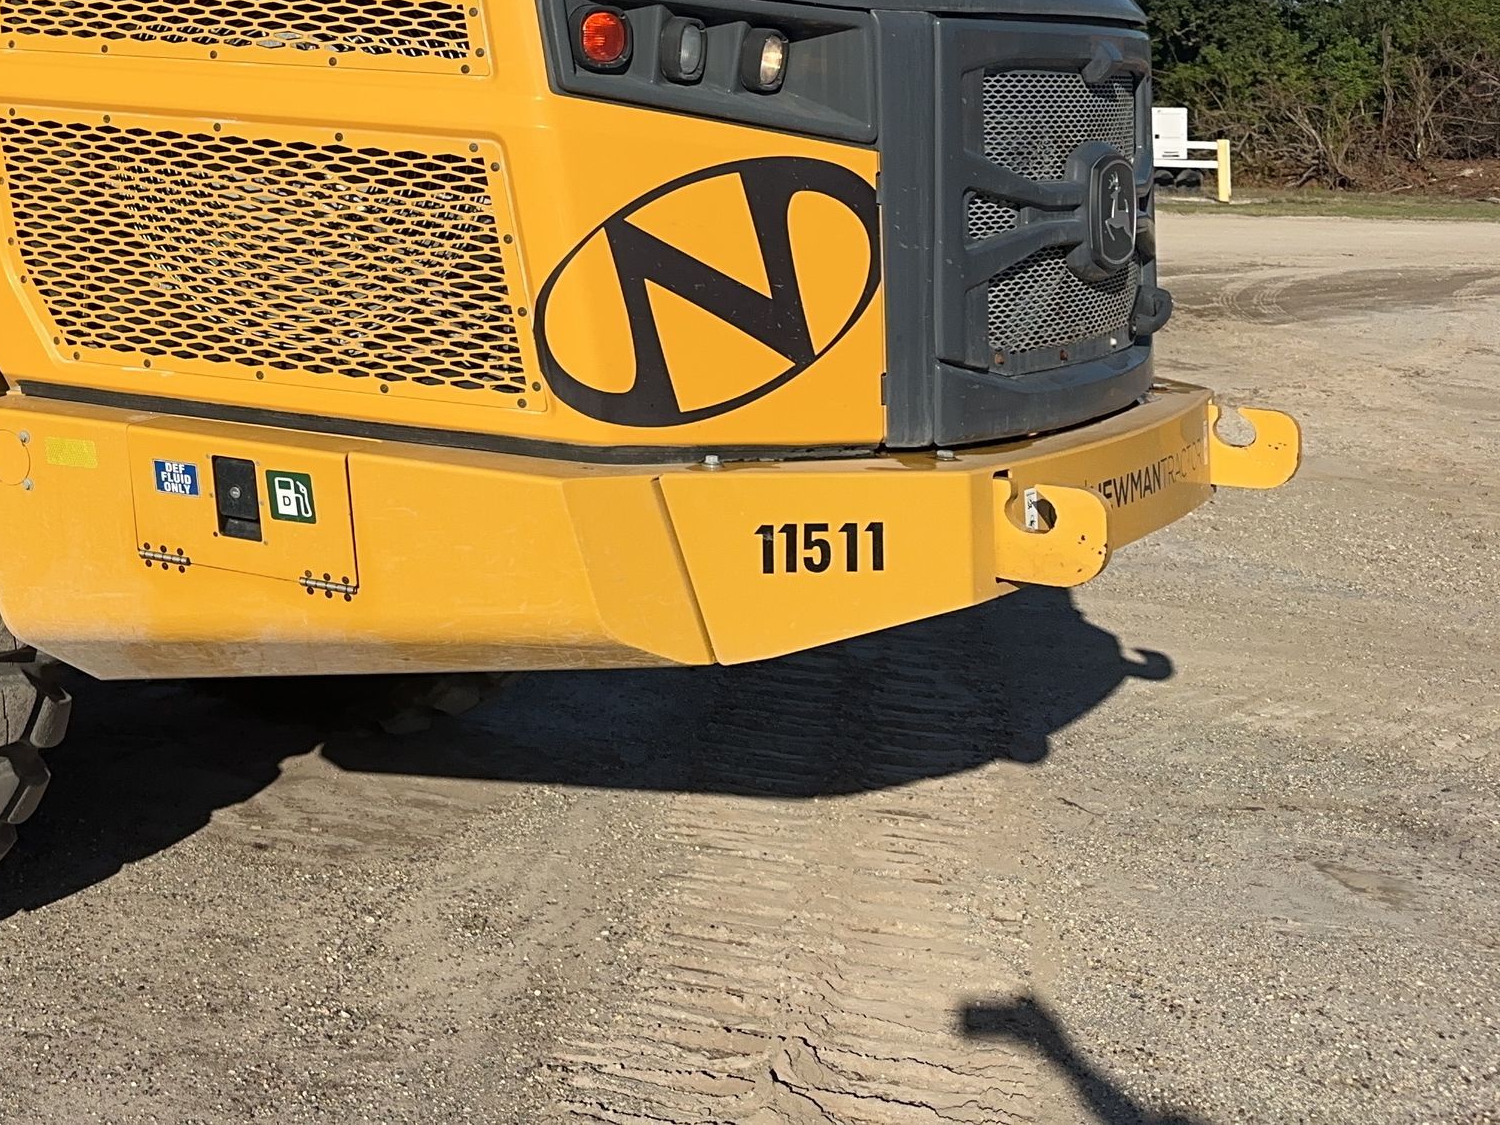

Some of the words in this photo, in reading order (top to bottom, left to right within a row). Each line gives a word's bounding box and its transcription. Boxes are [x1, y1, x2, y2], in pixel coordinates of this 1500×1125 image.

[164, 462, 186, 474] DEF
[160, 471, 192, 485] FLUID
[163, 481, 191, 495] ONLY
[754, 521, 885, 575] 11511
